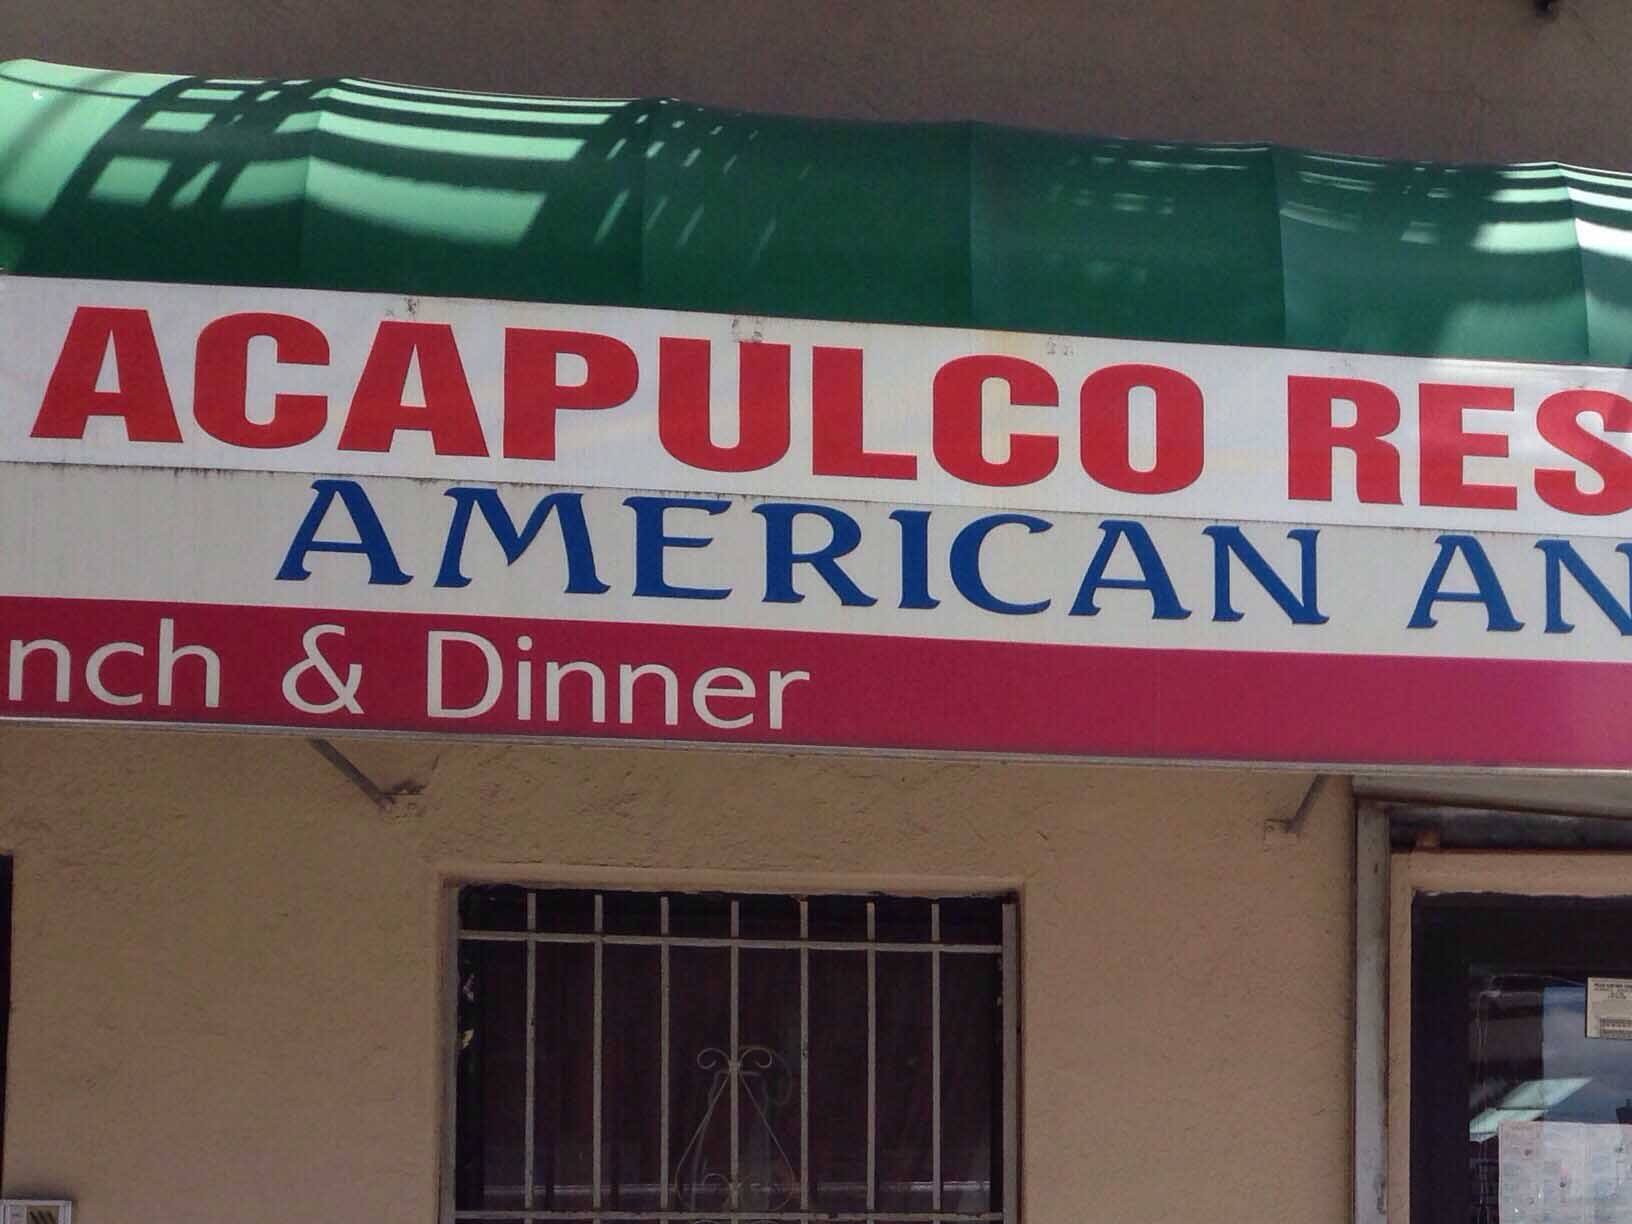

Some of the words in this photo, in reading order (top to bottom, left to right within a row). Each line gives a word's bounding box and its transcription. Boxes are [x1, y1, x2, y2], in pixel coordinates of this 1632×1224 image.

[30, 306, 1205, 495] ACAPULCO
[275, 479, 1329, 625] AMERICAN
[9, 618, 221, 708] nch
[282, 624, 364, 714] &
[427, 631, 810, 730] Dinner
